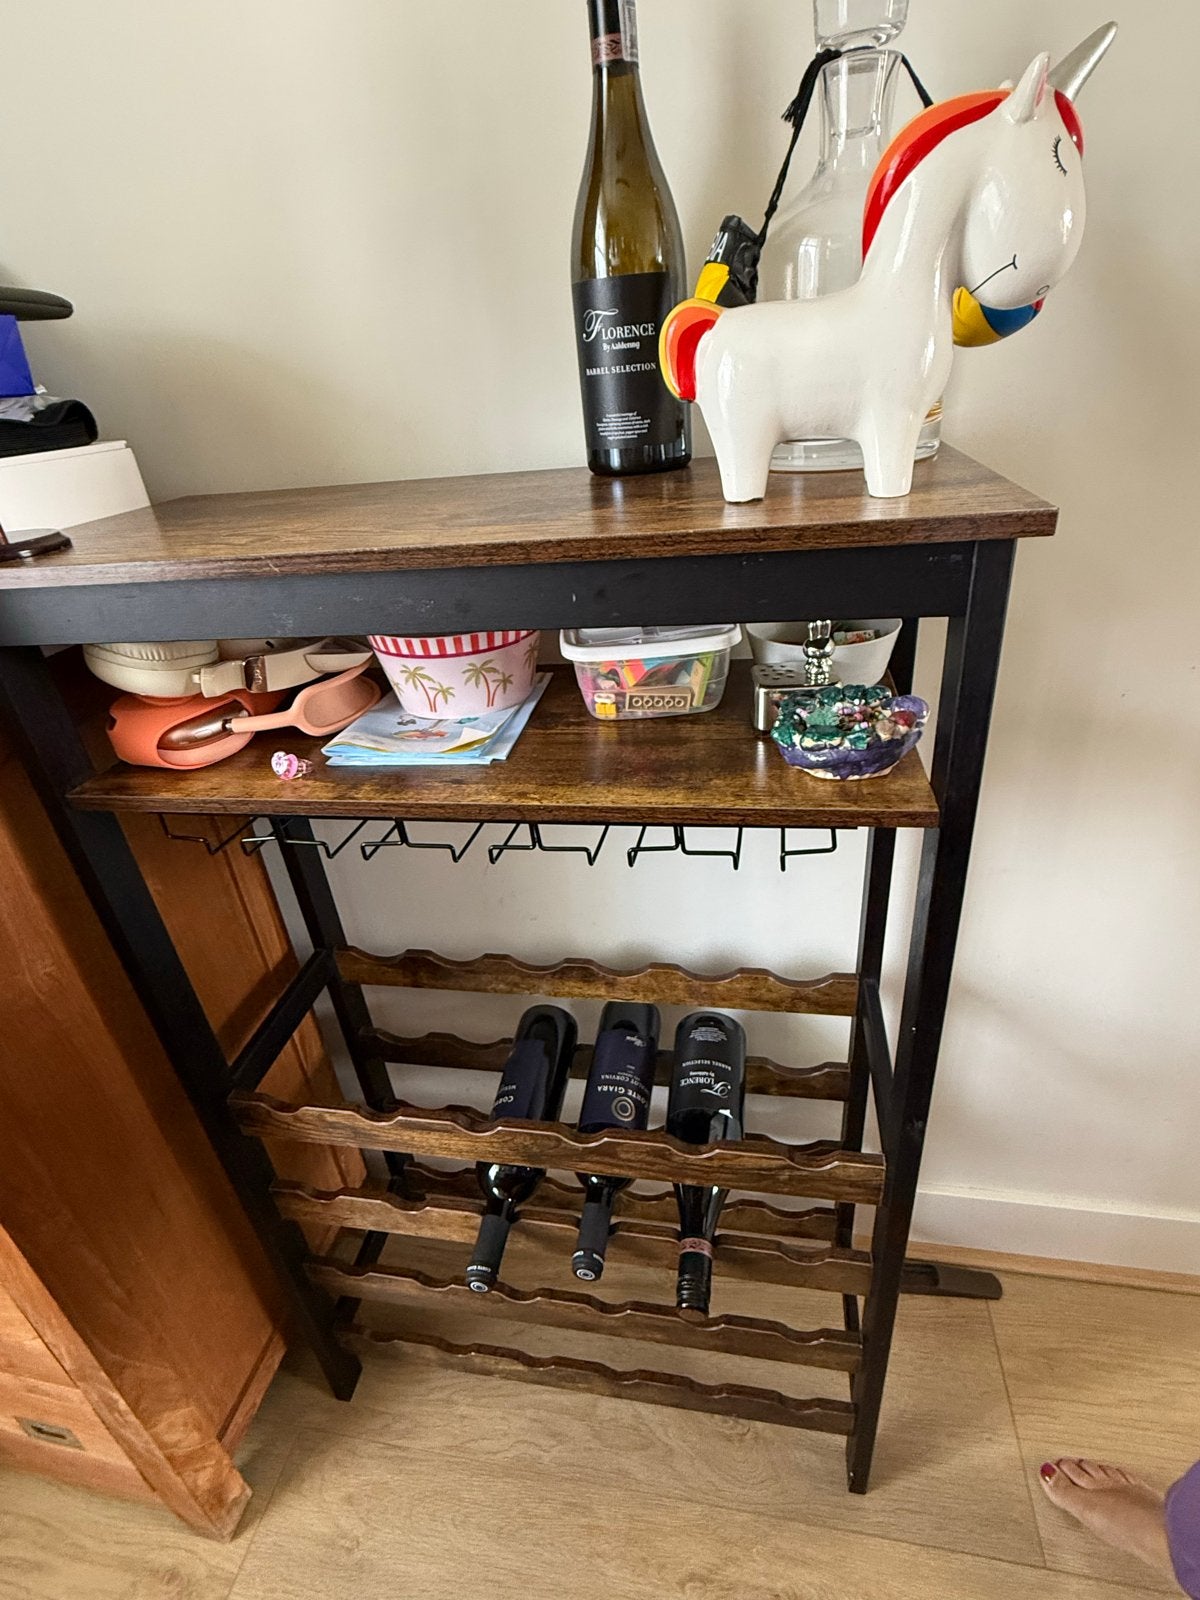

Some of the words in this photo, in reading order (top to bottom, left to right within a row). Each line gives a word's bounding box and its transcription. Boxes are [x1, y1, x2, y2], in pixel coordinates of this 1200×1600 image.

[583, 308, 656, 342] FLORENCE
[603, 343, 610, 353] By
[586, 366, 610, 376] BARREL
[611, 362, 657, 374] SELECTION
[597, 1085, 625, 1094] GIARA
[680, 1076, 732, 1098] FLORENCE
